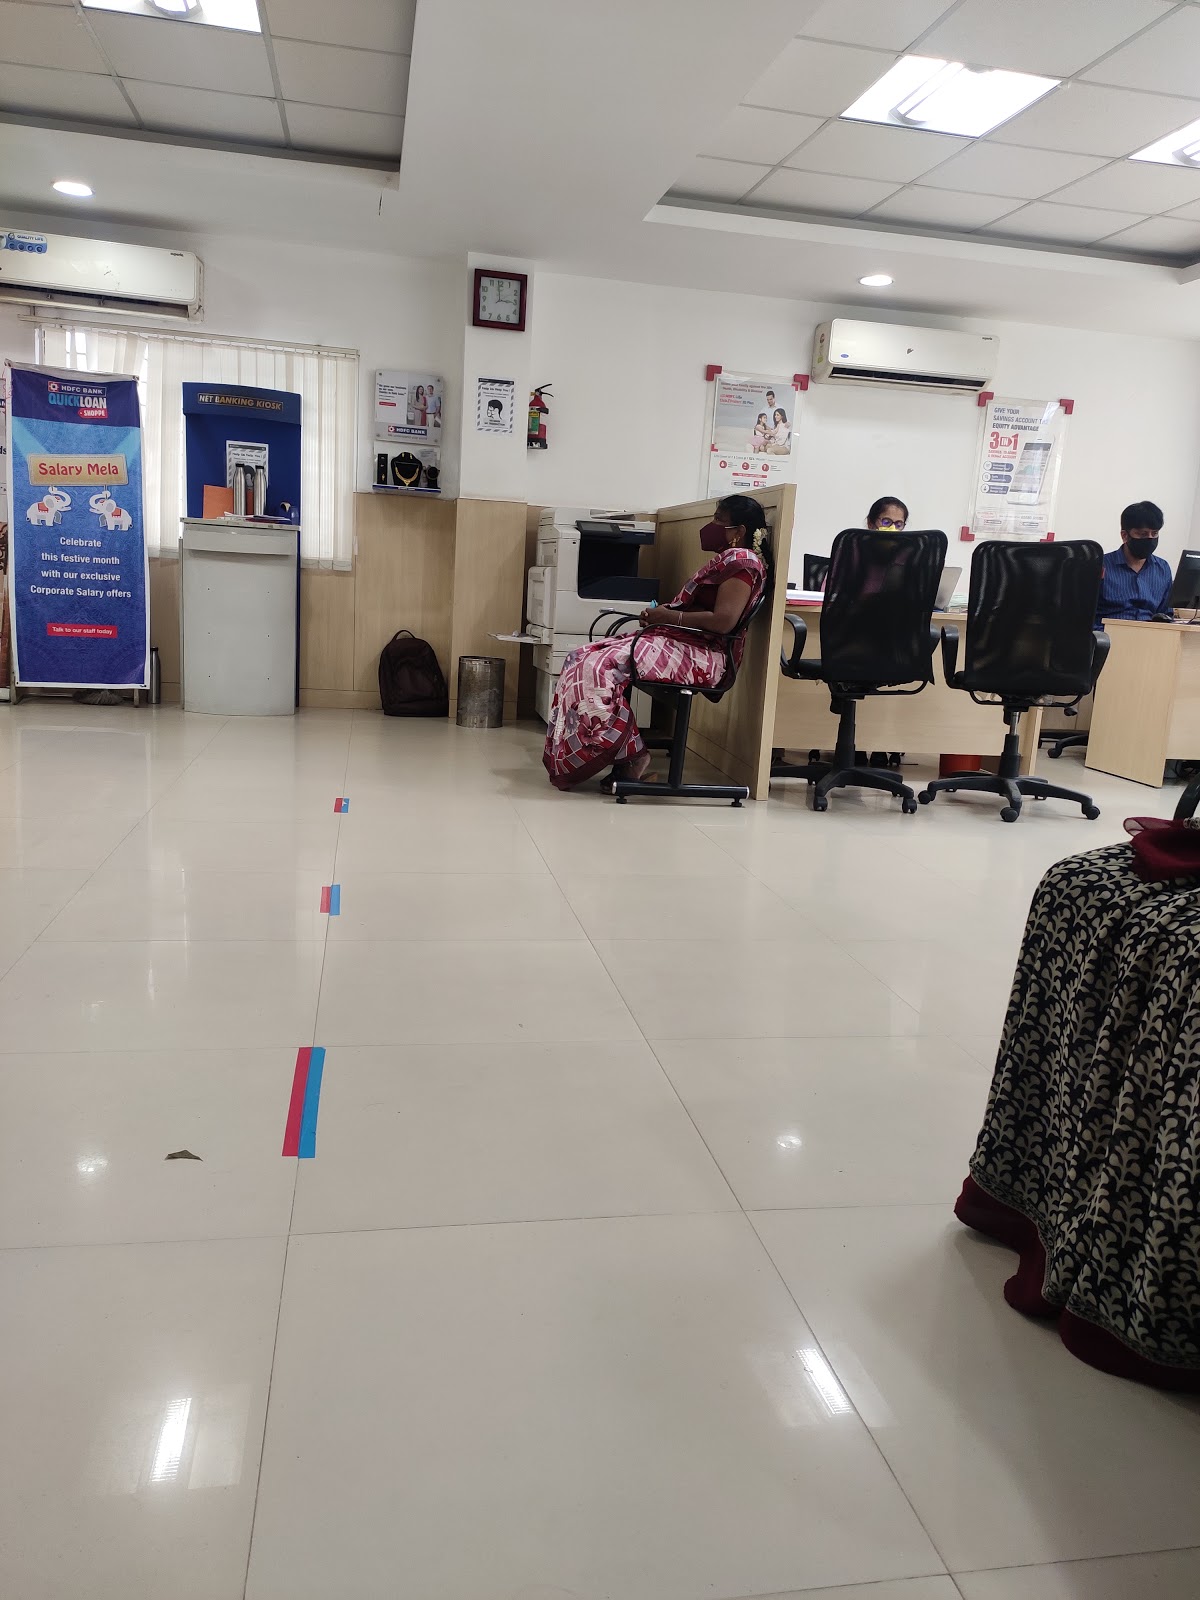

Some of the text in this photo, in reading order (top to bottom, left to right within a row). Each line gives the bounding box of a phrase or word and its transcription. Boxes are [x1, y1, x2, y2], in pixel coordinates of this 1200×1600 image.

[215, 396, 254, 406] BANKING
[256, 400, 282, 410] KIOSK
[38, 462, 119, 476] Salary Mela
[60, 537, 102, 547] Celebrate
[42, 552, 120, 565] this festive month
[41, 570, 61, 578] with
[80, 572, 121, 581] exclusive
[30, 585, 132, 598] Corporate Salary offers
